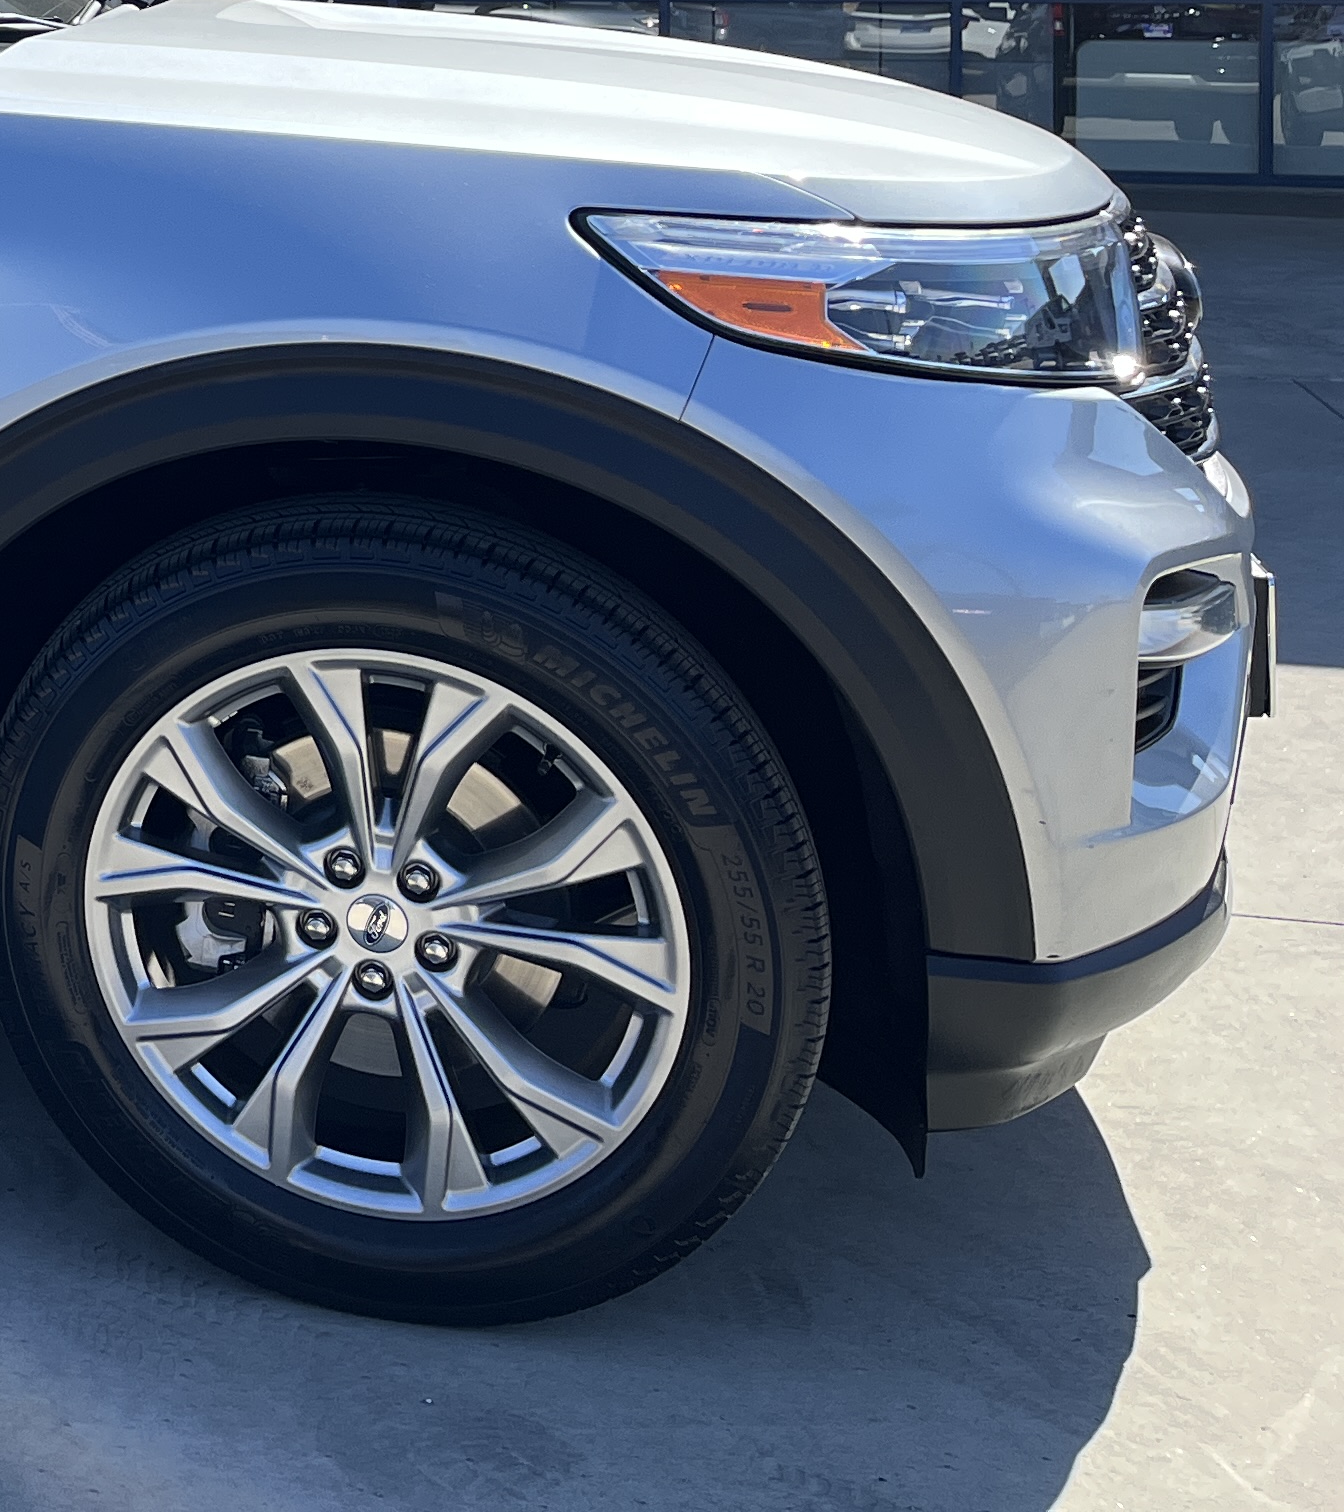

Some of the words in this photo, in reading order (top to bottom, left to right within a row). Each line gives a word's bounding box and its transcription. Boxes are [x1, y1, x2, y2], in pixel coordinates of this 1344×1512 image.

[532, 644, 718, 817] MICHELIN
[18, 859, 32, 894] A/S
[721, 852, 761, 947] 255/55
[745, 954, 766, 973] R
[745, 982, 766, 1017] 20
